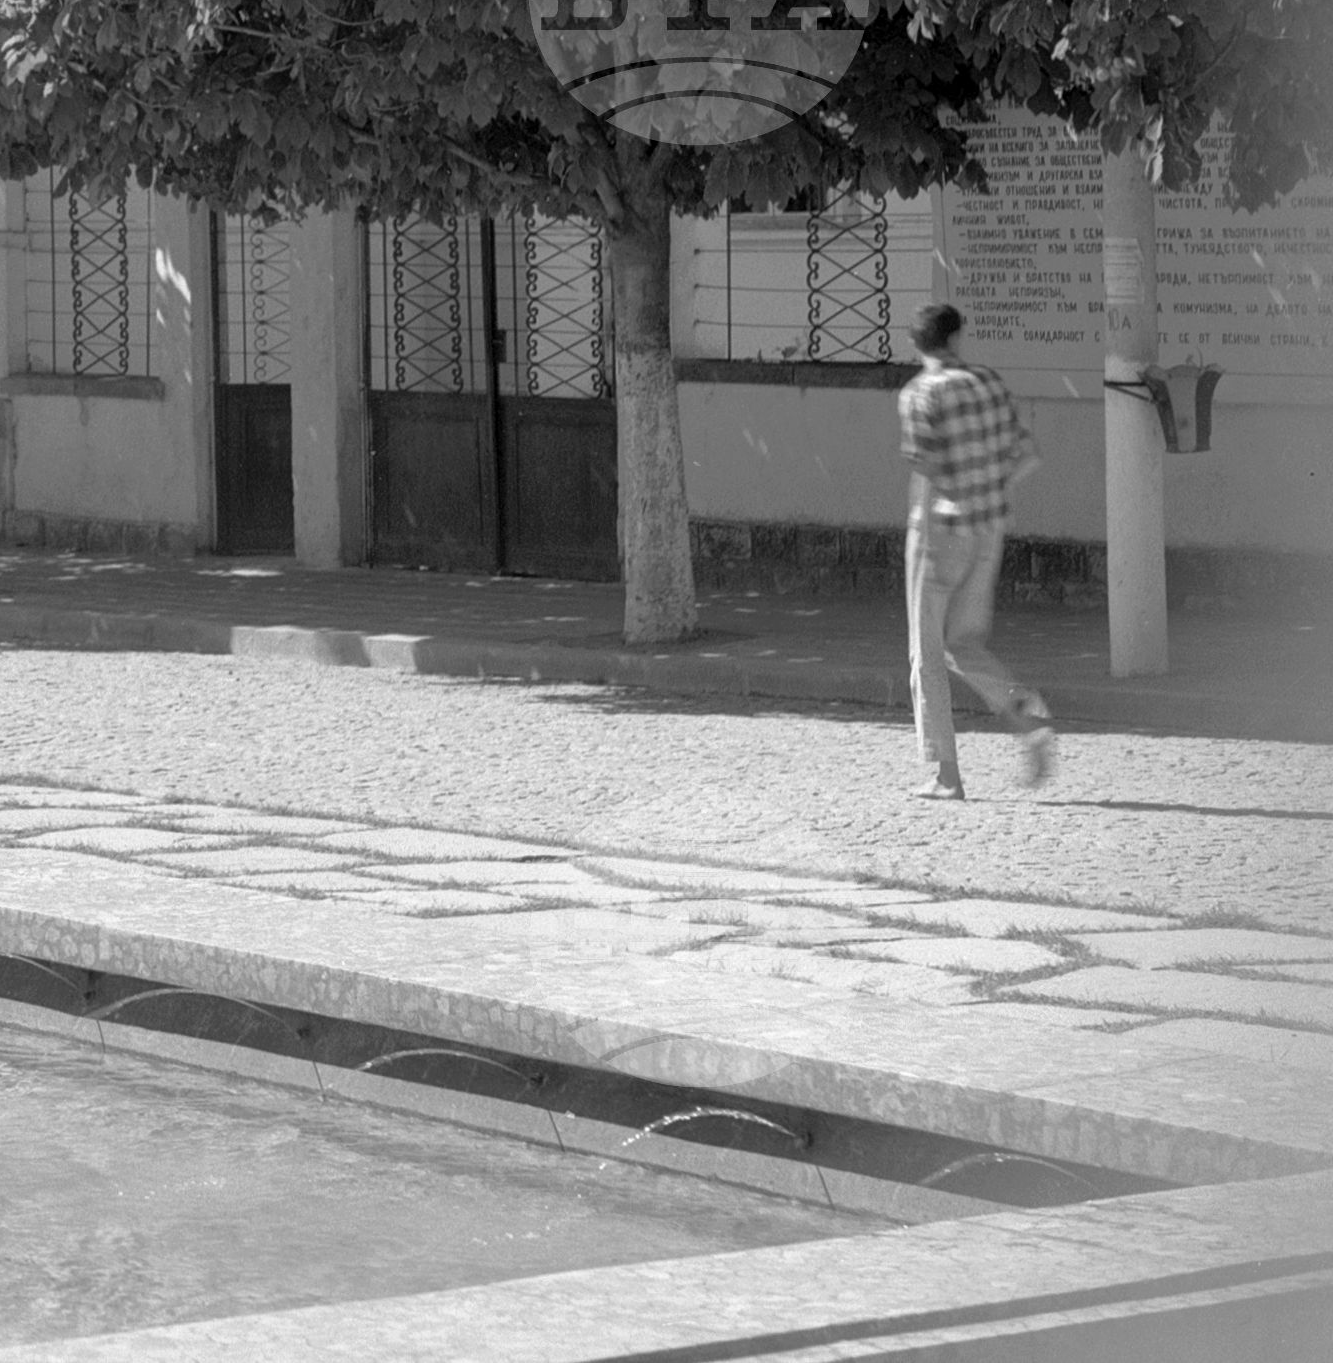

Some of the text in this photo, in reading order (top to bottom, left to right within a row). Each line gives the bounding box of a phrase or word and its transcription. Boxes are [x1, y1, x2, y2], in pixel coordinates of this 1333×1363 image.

[1050, 155, 1102, 168] ОБЩЕСТВЕНИ
[1089, 169, 1103, 181] ВЗА
[1075, 184, 1103, 195] ВЗАИМ
[1013, 200, 1019, 210] И
[1083, 228, 1104, 239] СЕМ
[1199, 228, 1214, 239] ЗА
[1048, 244, 1067, 255] КЪМ
[1074, 243, 1103, 254] НЕСПР
[1013, 273, 1020, 283] И
[1079, 273, 1092, 283] НА
[1156, 273, 1192, 286] АРОДИ,
[1057, 302, 1077, 312] КЪМ
[1088, 302, 1105, 313] ВРА
